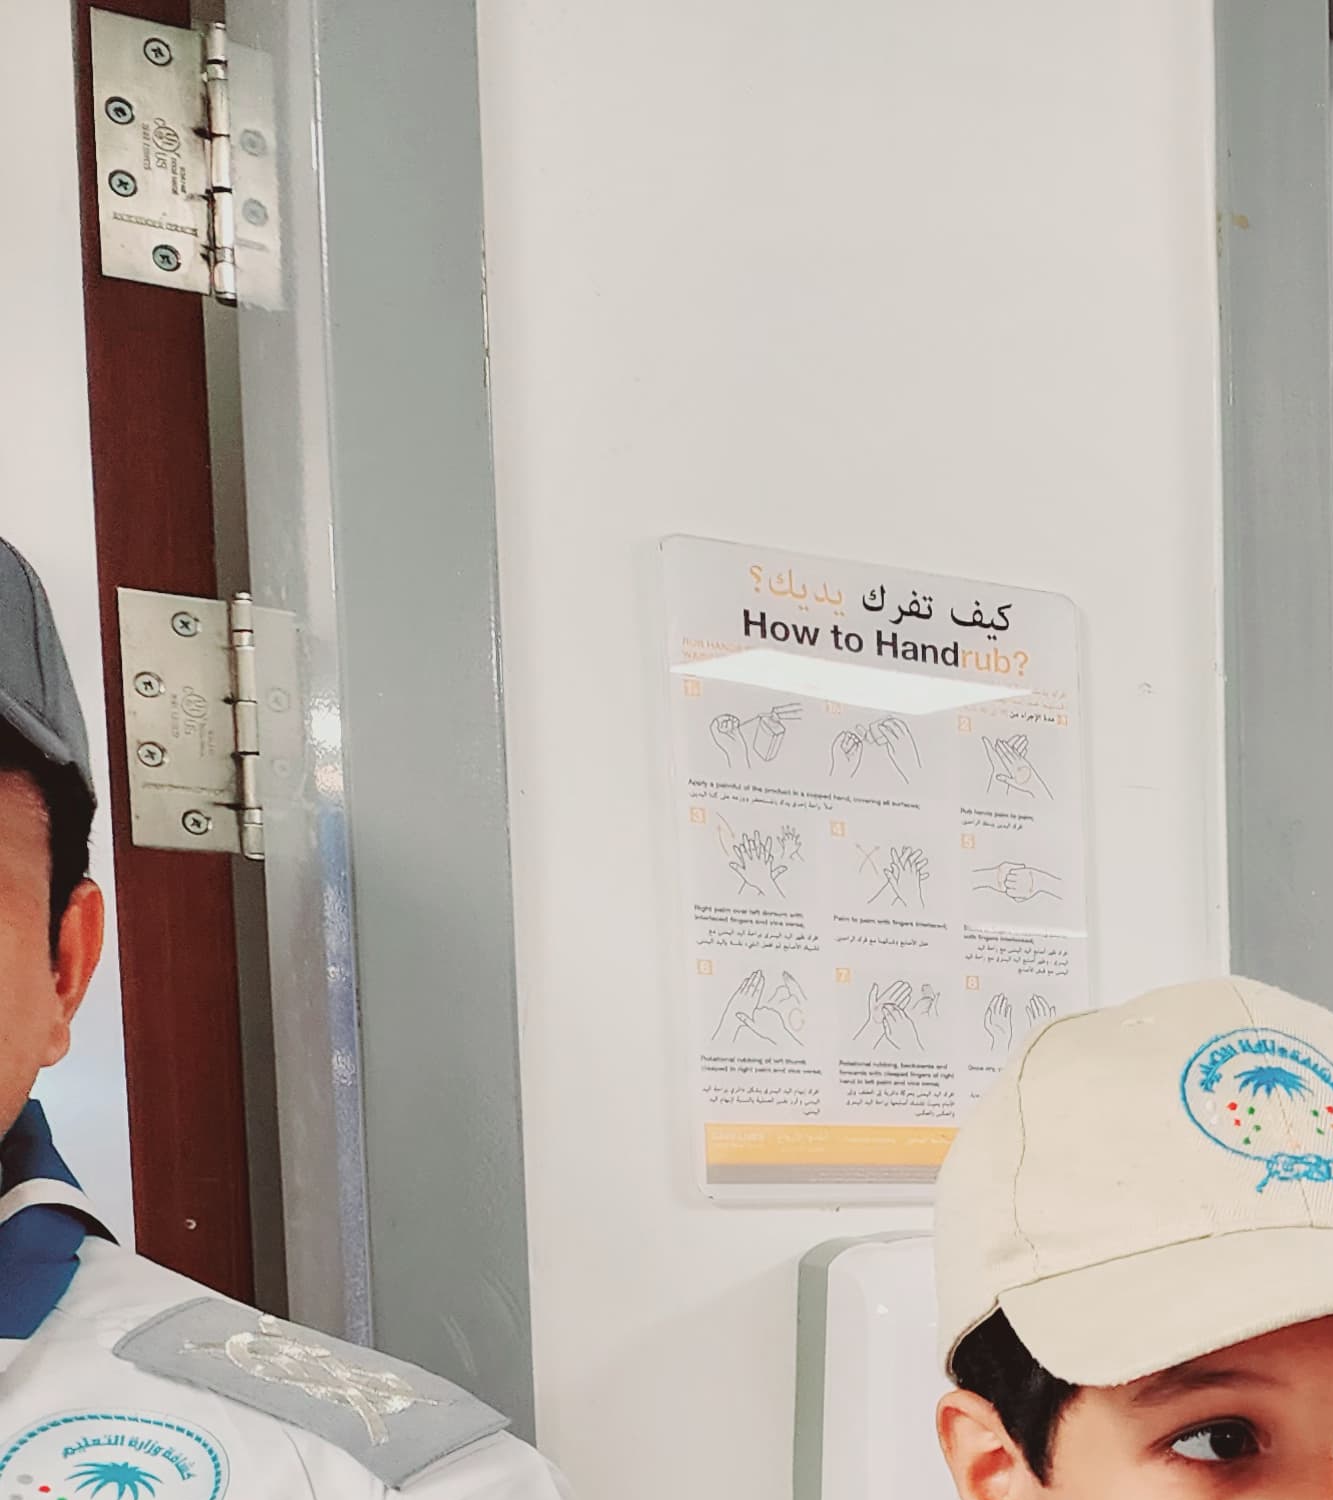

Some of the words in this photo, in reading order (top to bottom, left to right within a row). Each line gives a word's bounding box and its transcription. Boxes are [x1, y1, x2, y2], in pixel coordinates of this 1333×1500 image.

[861, 583, 934, 624] تفرك
[950, 600, 1013, 641] كيف
[742, 609, 820, 647] How
[831, 625, 864, 653] to
[876, 631, 1030, 677] Handrub?
[61, 1433, 125, 1460] التعليم
[128, 1434, 164, 1458] وزارة
